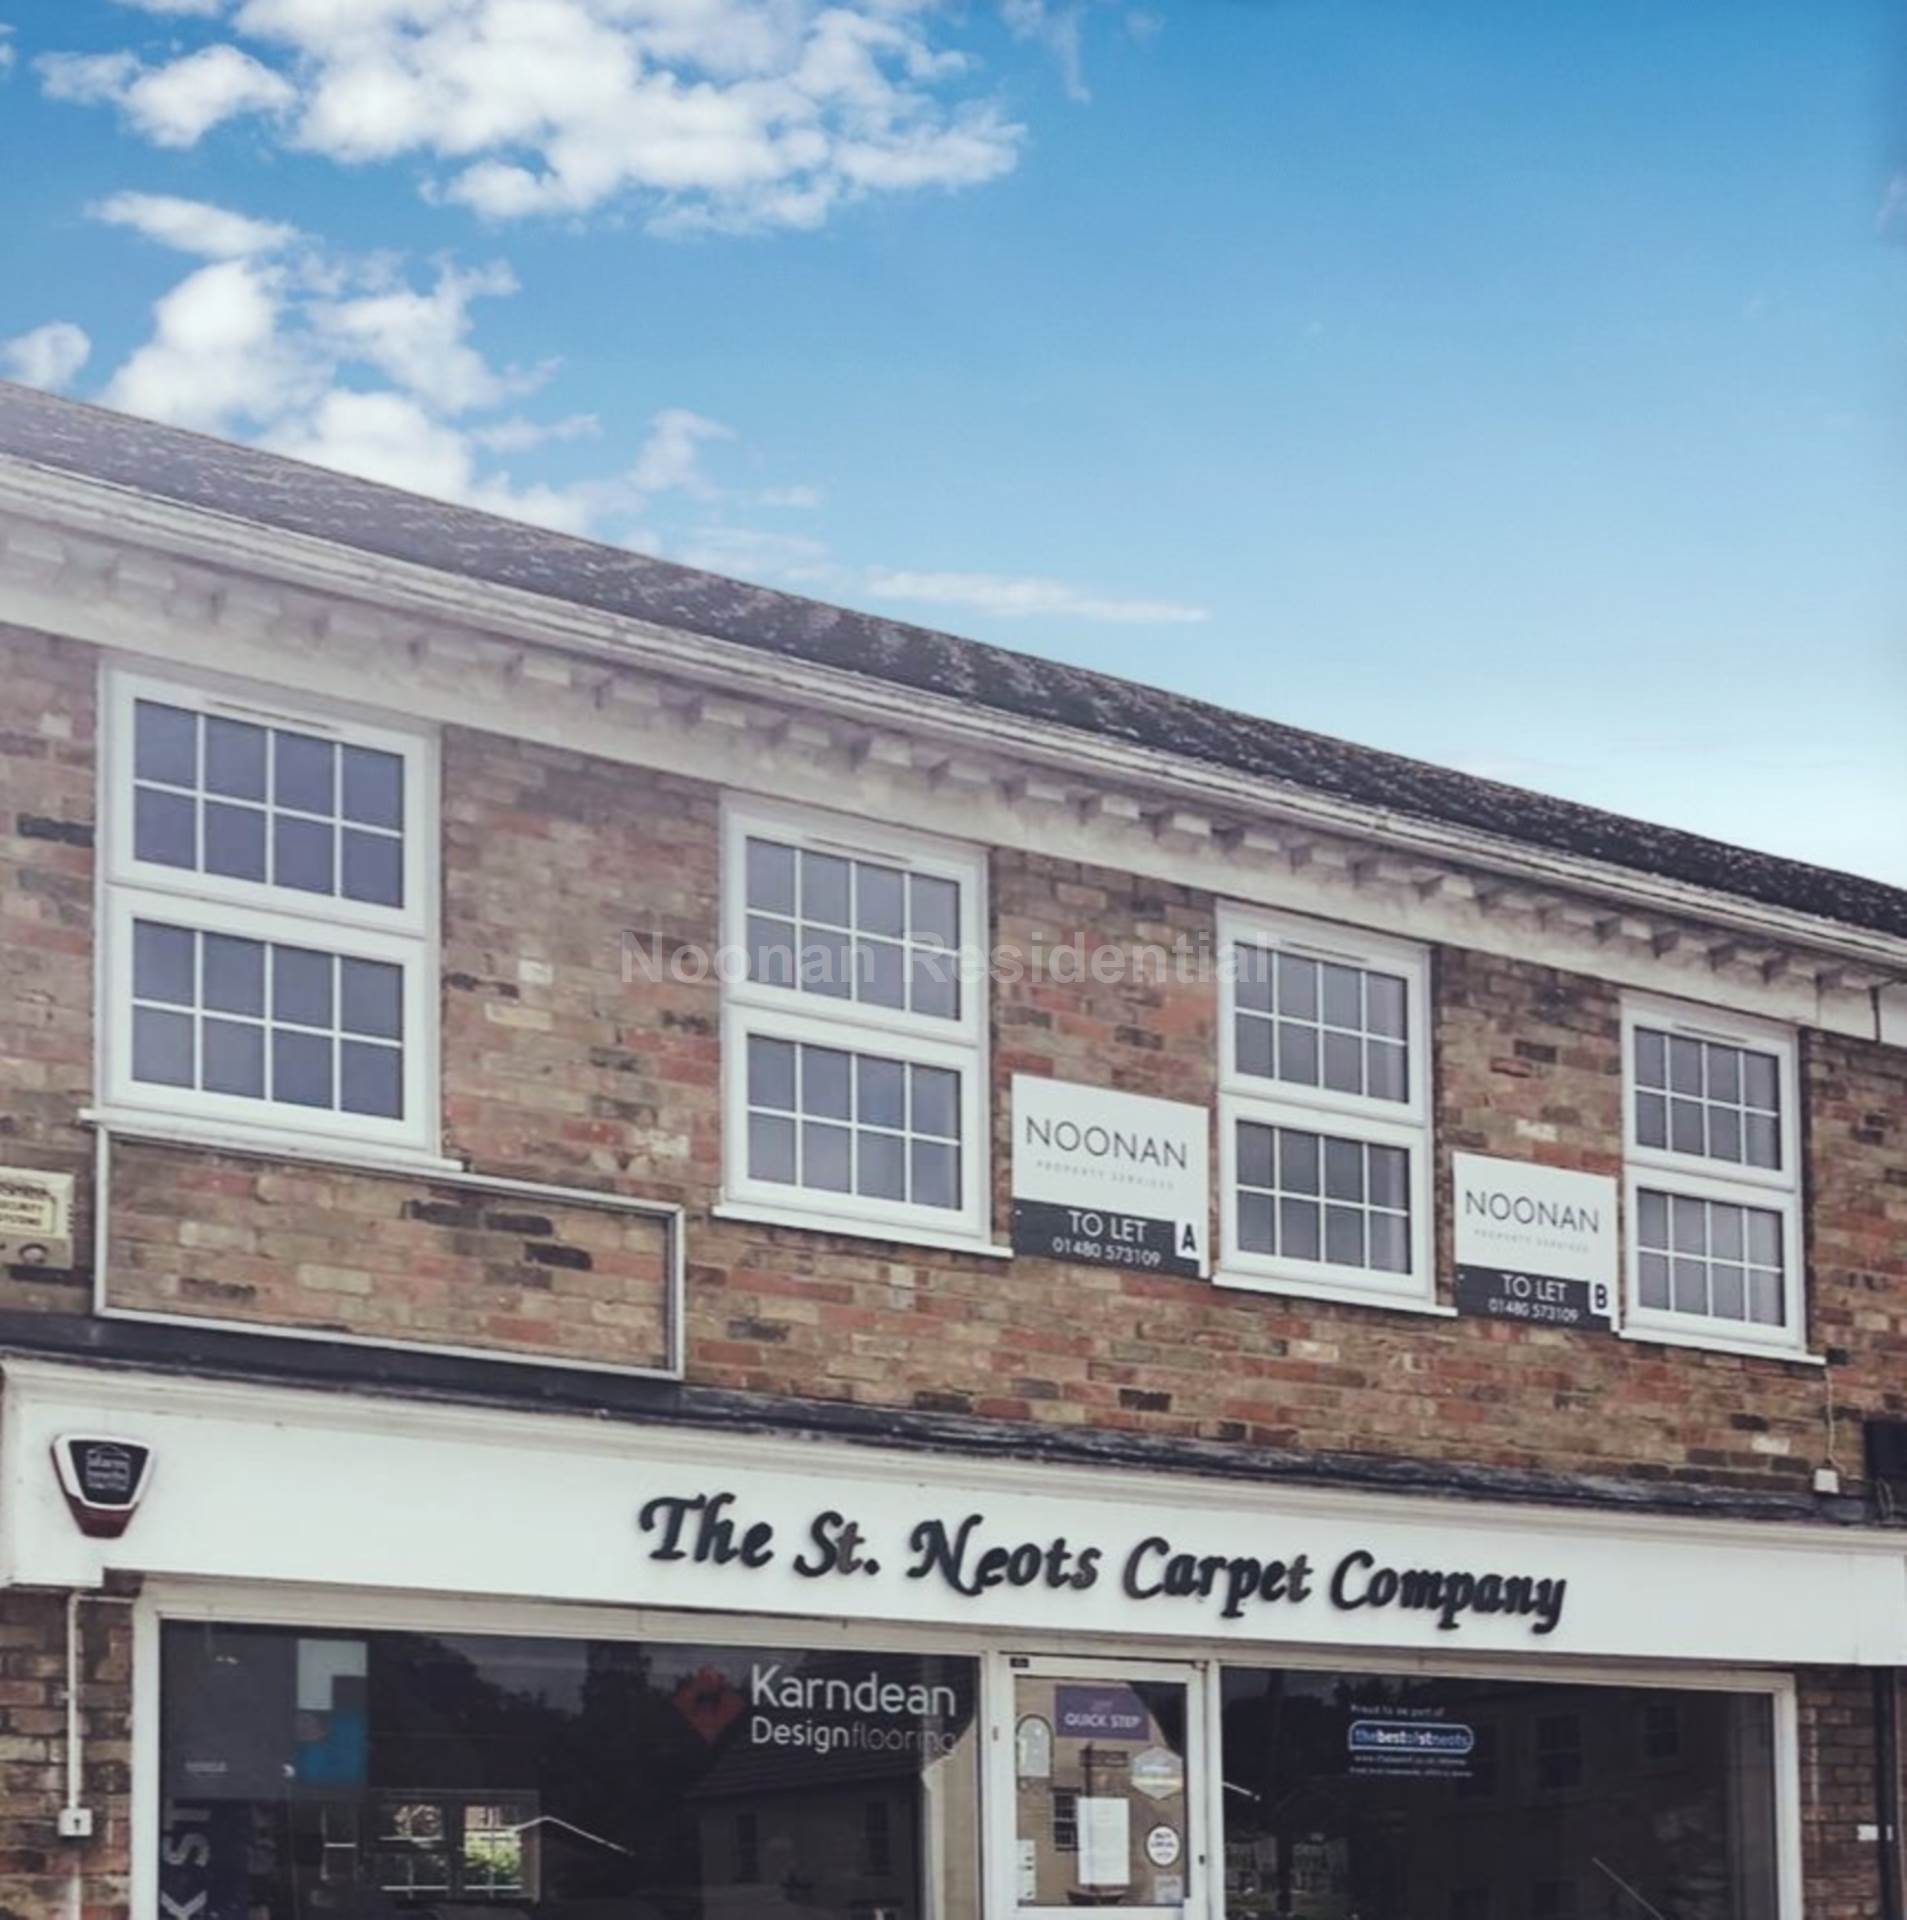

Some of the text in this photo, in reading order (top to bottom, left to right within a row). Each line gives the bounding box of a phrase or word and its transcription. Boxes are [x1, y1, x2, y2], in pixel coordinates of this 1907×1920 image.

[1026, 1116, 1186, 1169] NOONAN
[1037, 1160, 1104, 1177] PROPERTY
[1068, 1210, 1147, 1243] TO LET
[1465, 1190, 1599, 1234] NOONAN
[1052, 1236, 1162, 1267] 01480 573109
[1181, 1223, 1197, 1252] A
[1501, 1274, 1568, 1302] TO LET
[1594, 1283, 1608, 1310] B
[1488, 1298, 1580, 1323] 01480 573109
[639, 1492, 1567, 1635] The St. Neots Carpet Company
[752, 1663, 956, 1717] Karndean
[1064, 1712, 1142, 1729] QUICK STEP
